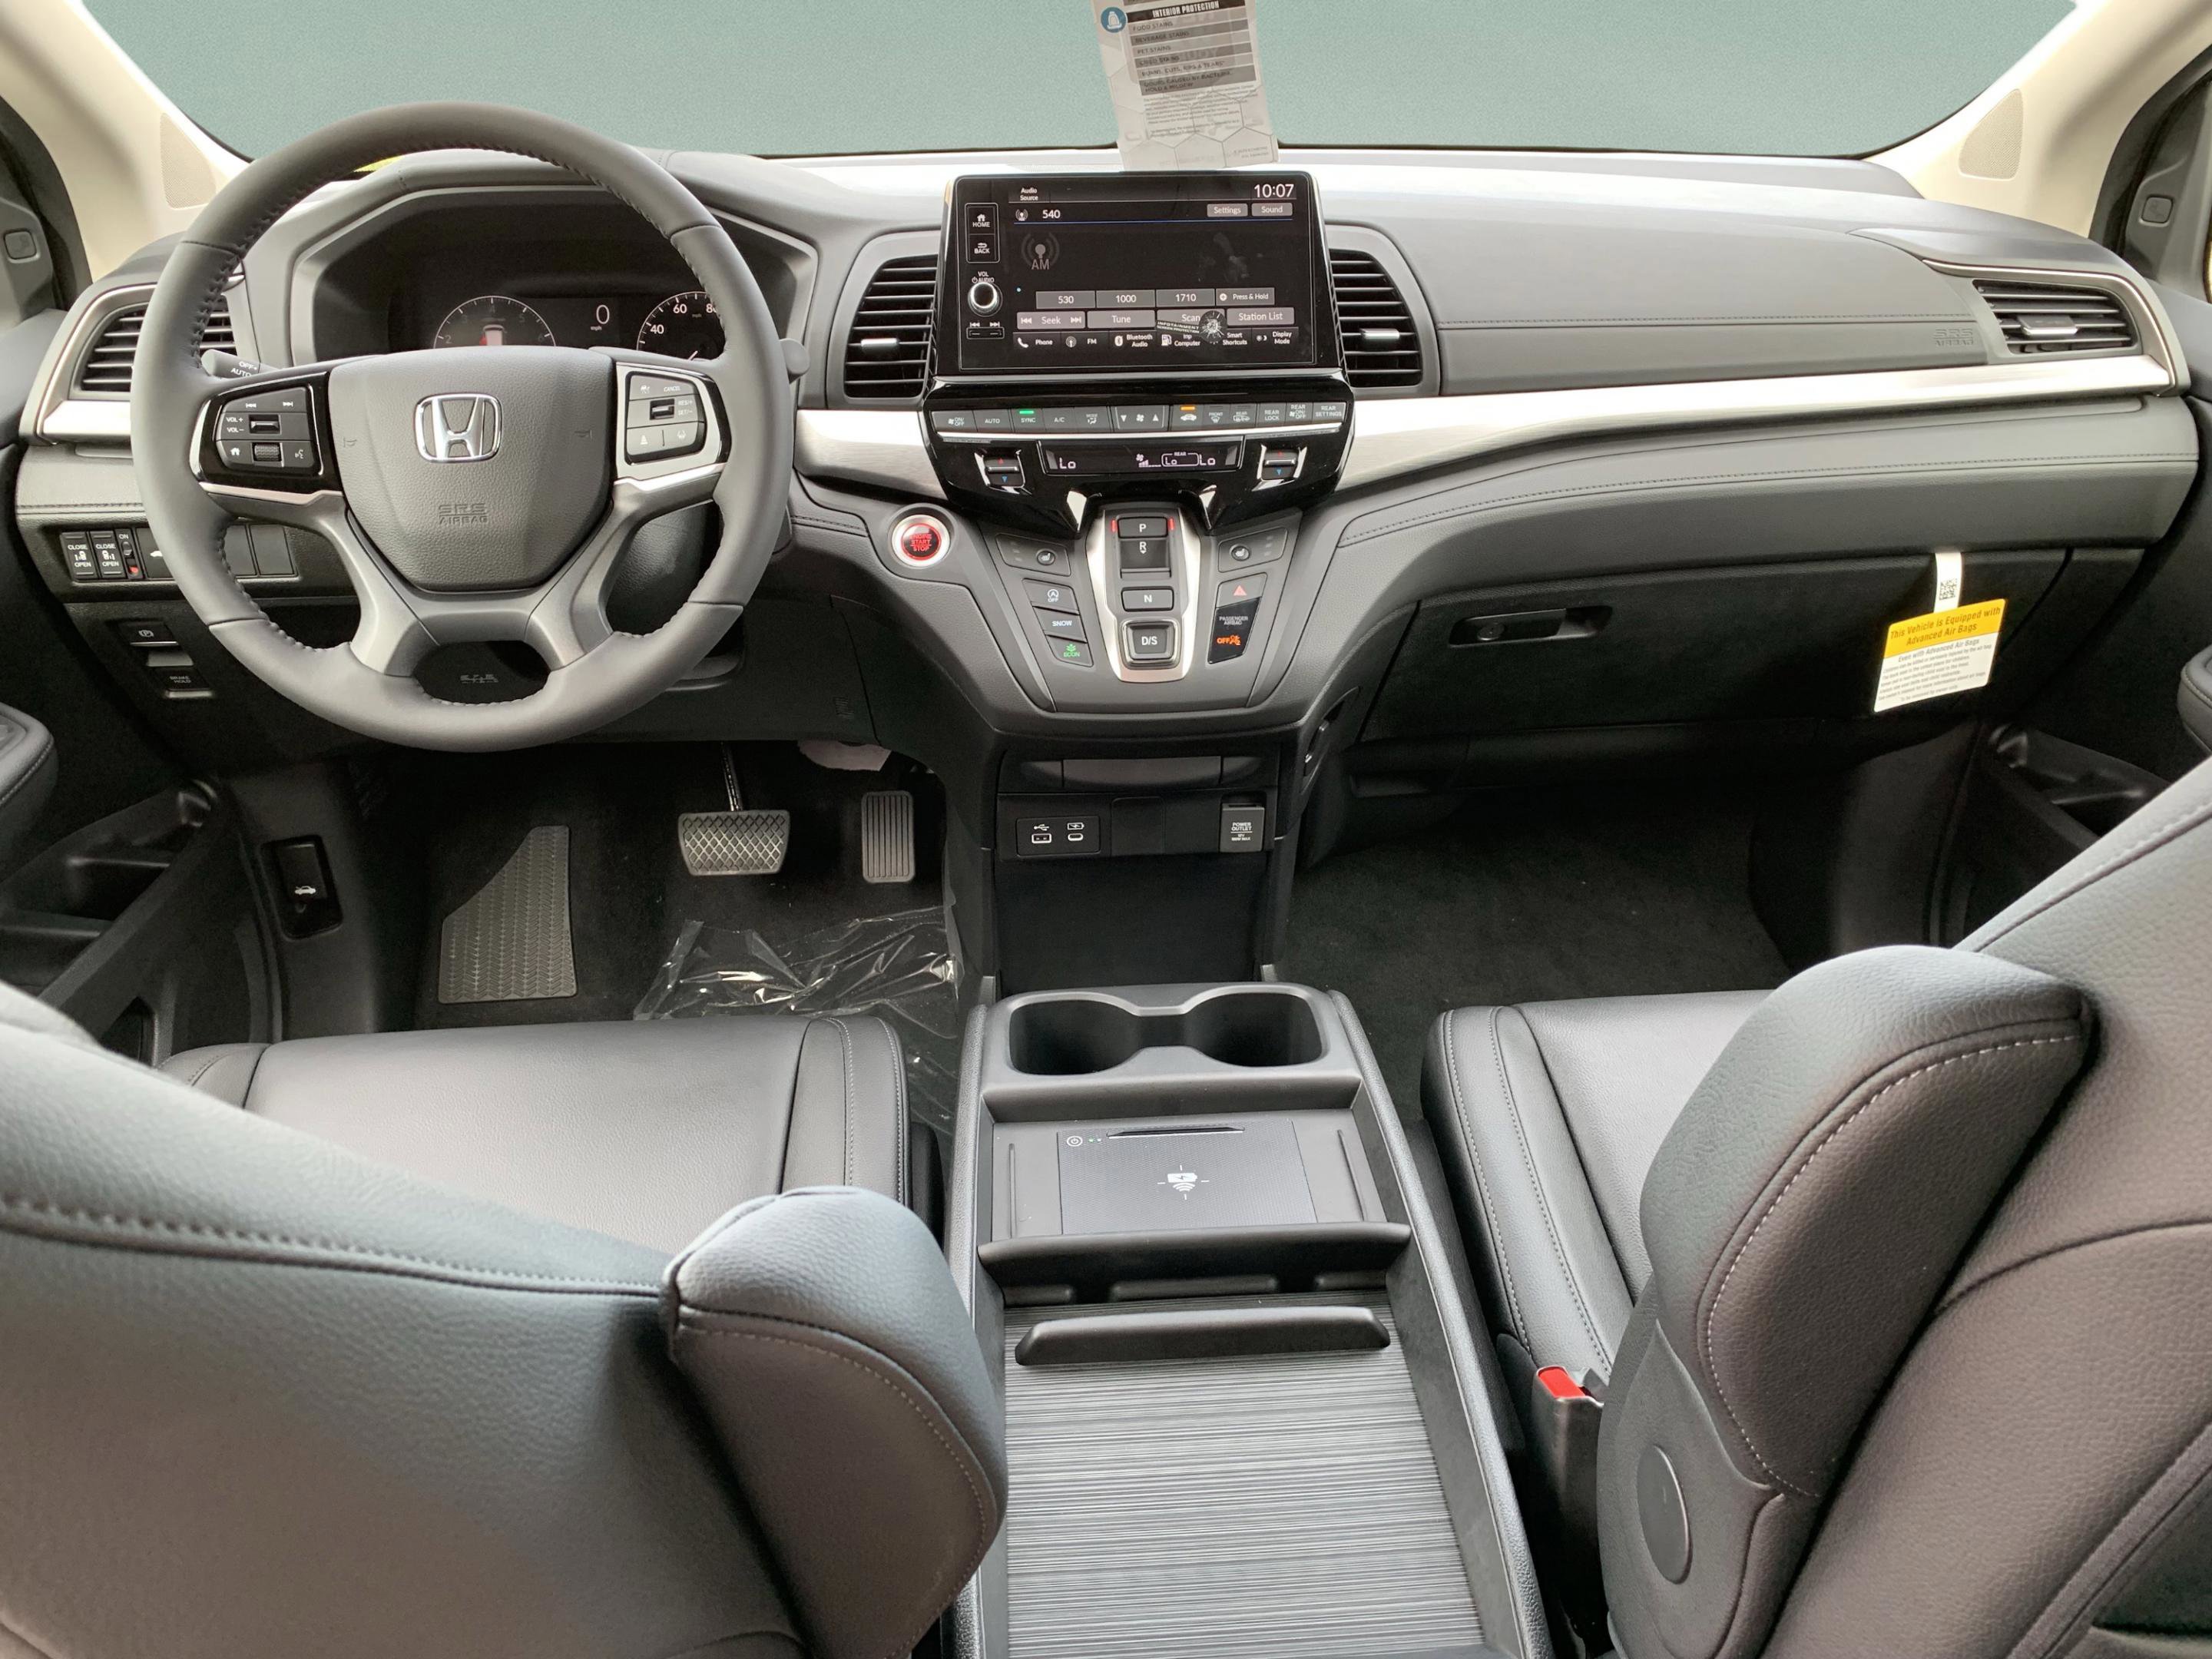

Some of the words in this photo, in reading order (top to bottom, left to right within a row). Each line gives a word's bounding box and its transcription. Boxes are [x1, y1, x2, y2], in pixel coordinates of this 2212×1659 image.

[1152, 7, 1181, 18] INTERIOR
[1182, 1, 1219, 13] PROTECTION
[1135, 35, 1167, 43] BEVERAGE
[1254, 184, 1294, 197] 10:07
[1214, 206, 1241, 215] Settings
[1261, 205, 1283, 214] Sound
[1042, 210, 1061, 219] 540
[1031, 259, 1049, 270] AM
[1058, 296, 1075, 304] 530
[1115, 294, 1136, 303] 1000
[1175, 293, 1197, 302] 1710
[673, 304, 687, 313] 60
[706, 303, 717, 313] 8
[596, 304, 610, 324] 0
[1239, 313, 1267, 321] Station
[1041, 316, 1061, 325] Seek
[1111, 315, 1131, 323] Tune
[650, 324, 664, 334] 40
[1933, 328, 1973, 338] SRS
[445, 335, 452, 344] 2
[230, 367, 251, 377] AUTO
[1059, 458, 1076, 469] Lo
[1165, 457, 1177, 465] Lo
[1199, 453, 1216, 465] Lo
[439, 503, 486, 515] SRS
[439, 515, 488, 525] AIRBAG
[1139, 524, 1146, 532] P
[1140, 541, 1147, 550] R
[1144, 594, 1152, 603] N
[1891, 628, 1905, 639] This
[1907, 621, 1934, 634] Vehicle
[1936, 618, 1943, 627] is
[1945, 611, 1982, 625] Equipped
[1983, 607, 2001, 618] with
[1906, 631, 1942, 645] Advanced
[1944, 627, 1955, 636] Air
[1959, 623, 1977, 634] Bags
[1141, 636, 1157, 646] D/S
[1926, 644, 1954, 654] Advanced
[1965, 638, 1979, 647] Bags
